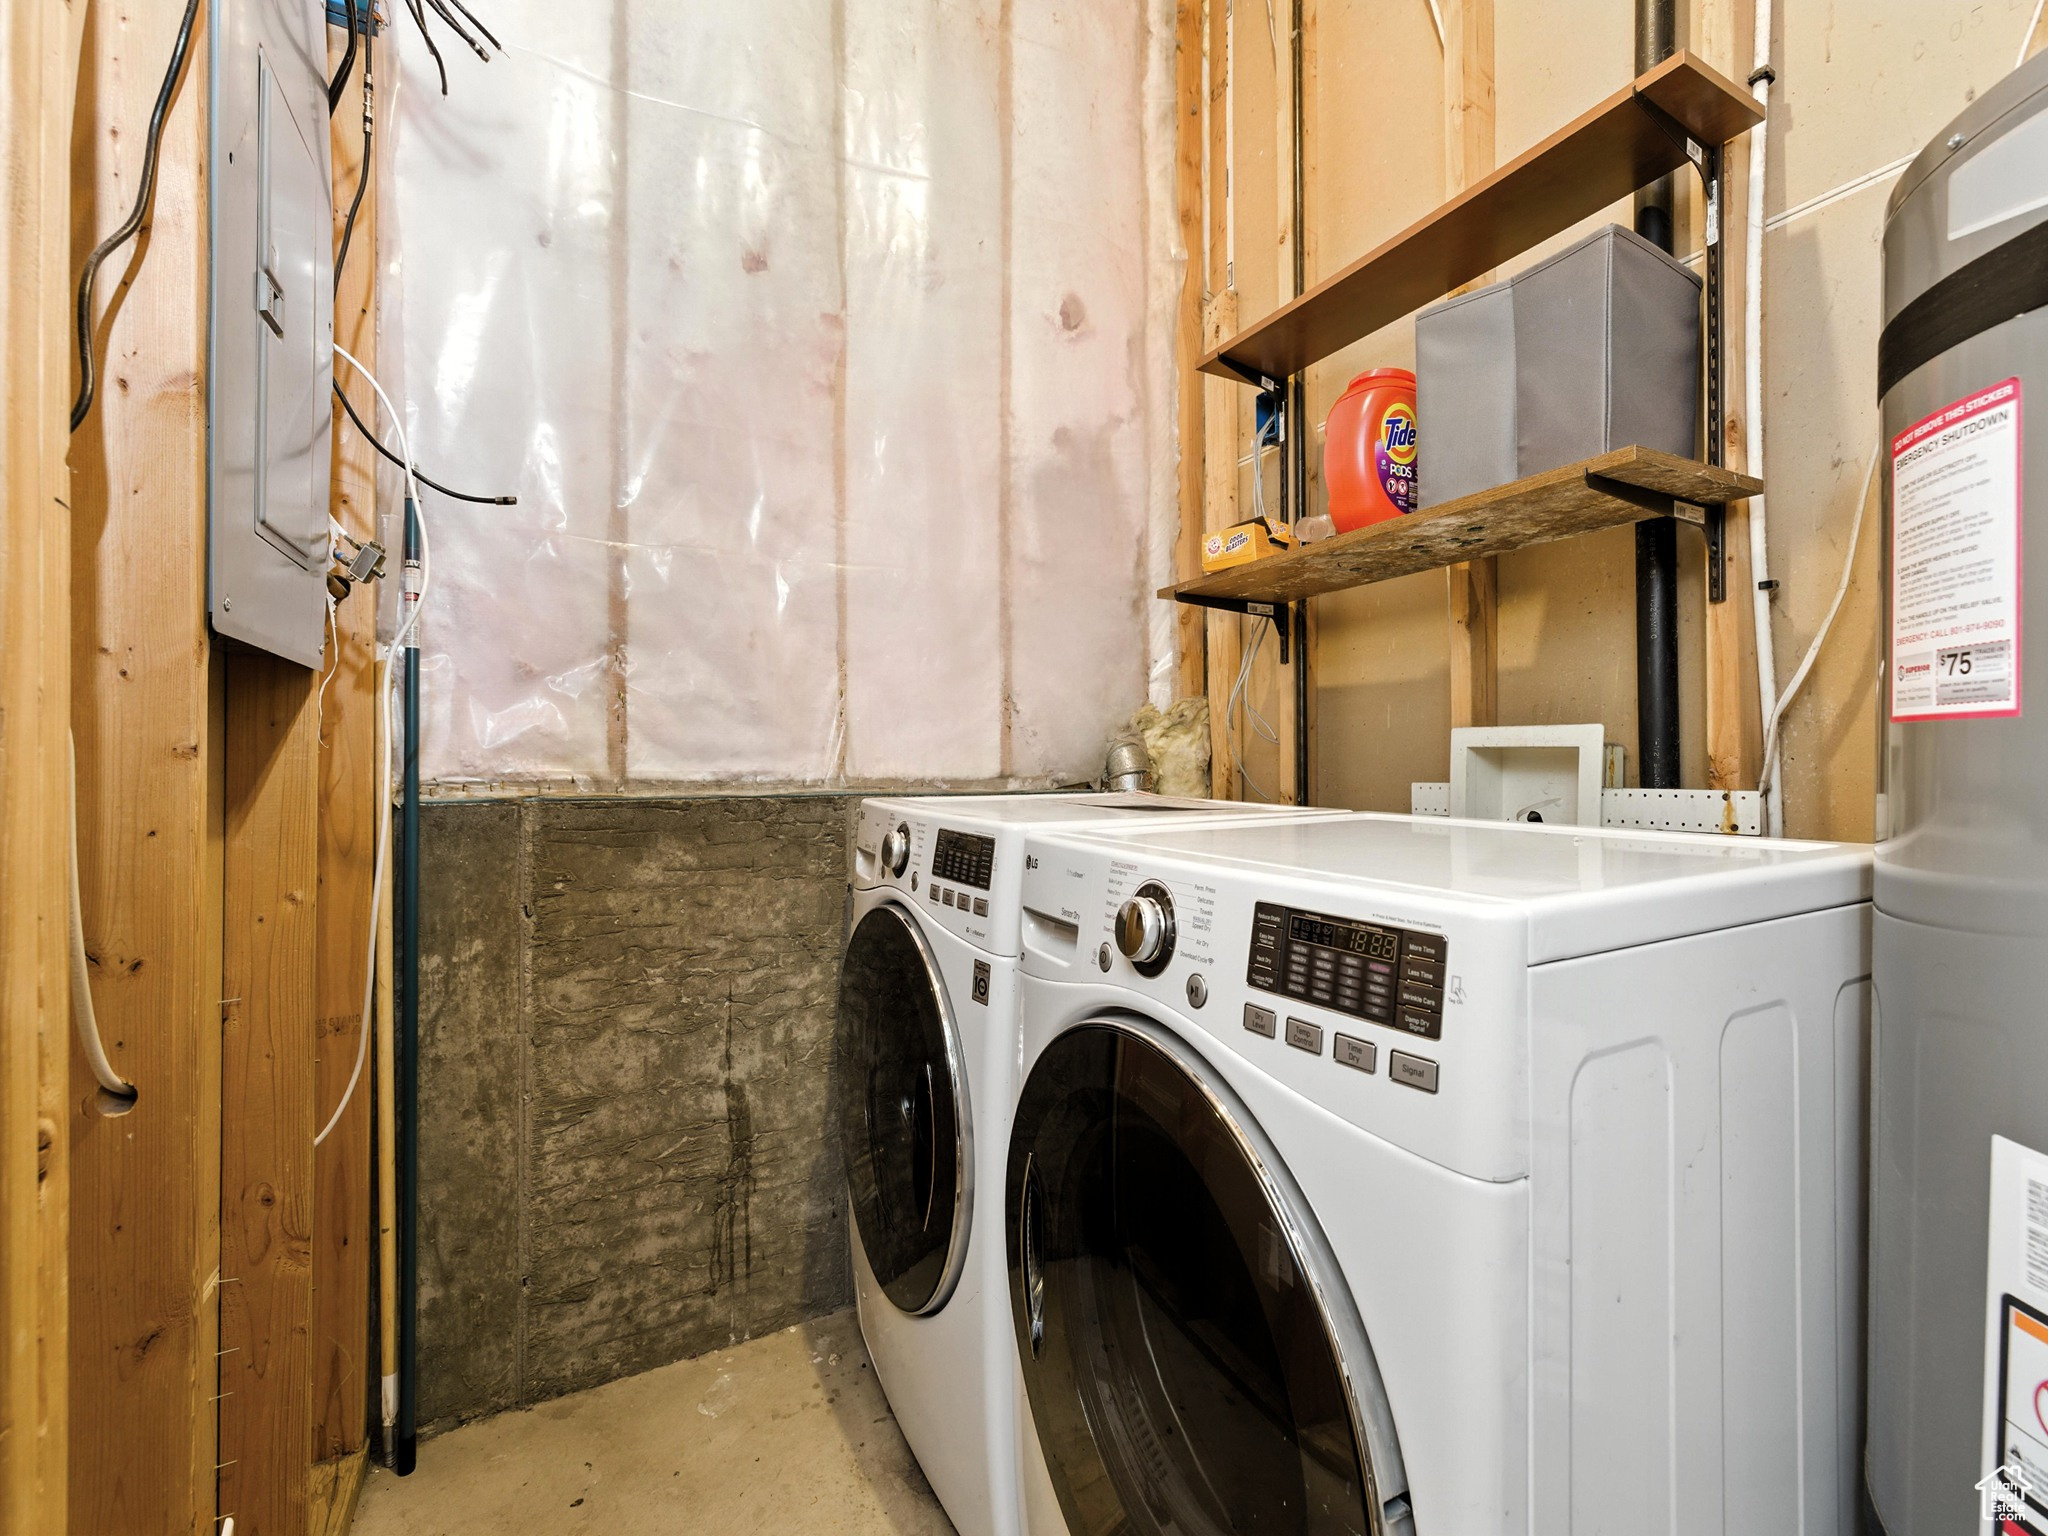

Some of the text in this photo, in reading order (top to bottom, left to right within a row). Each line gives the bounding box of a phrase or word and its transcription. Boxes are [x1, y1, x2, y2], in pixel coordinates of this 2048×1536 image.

[1914, 415, 1944, 438] REMOVE
[1945, 406, 1965, 422] THIS
[1966, 385, 2013, 412] STICKER
[1385, 418, 1417, 452] Tide
[1896, 439, 1940, 470] EMERGENCY
[1942, 409, 2009, 446] SHUTDOWN
[1390, 464, 1412, 478] PODS
[1226, 536, 1249, 552] BLASTERS
[1930, 628, 1948, 638] CALL
[1906, 664, 1930, 674] SUPERIOR
[1940, 651, 1972, 676] $75
[1061, 907, 1074, 918] Sensor
[1409, 944, 1435, 954] More Time
[1421, 971, 1433, 980] Time
[1403, 993, 1436, 1006] Wrinkle Care
[1255, 1012, 1263, 1022] Dry
[1405, 1015, 1430, 1028] Damp Dry
[1252, 1021, 1265, 1030] Level
[1409, 1023, 1425, 1033] Signal
[1294, 1035, 1313, 1047] Control
[1347, 1043, 1363, 1054] Time
[1348, 1053, 1360, 1064] Dry
[1402, 1064, 1424, 1078] Signal
